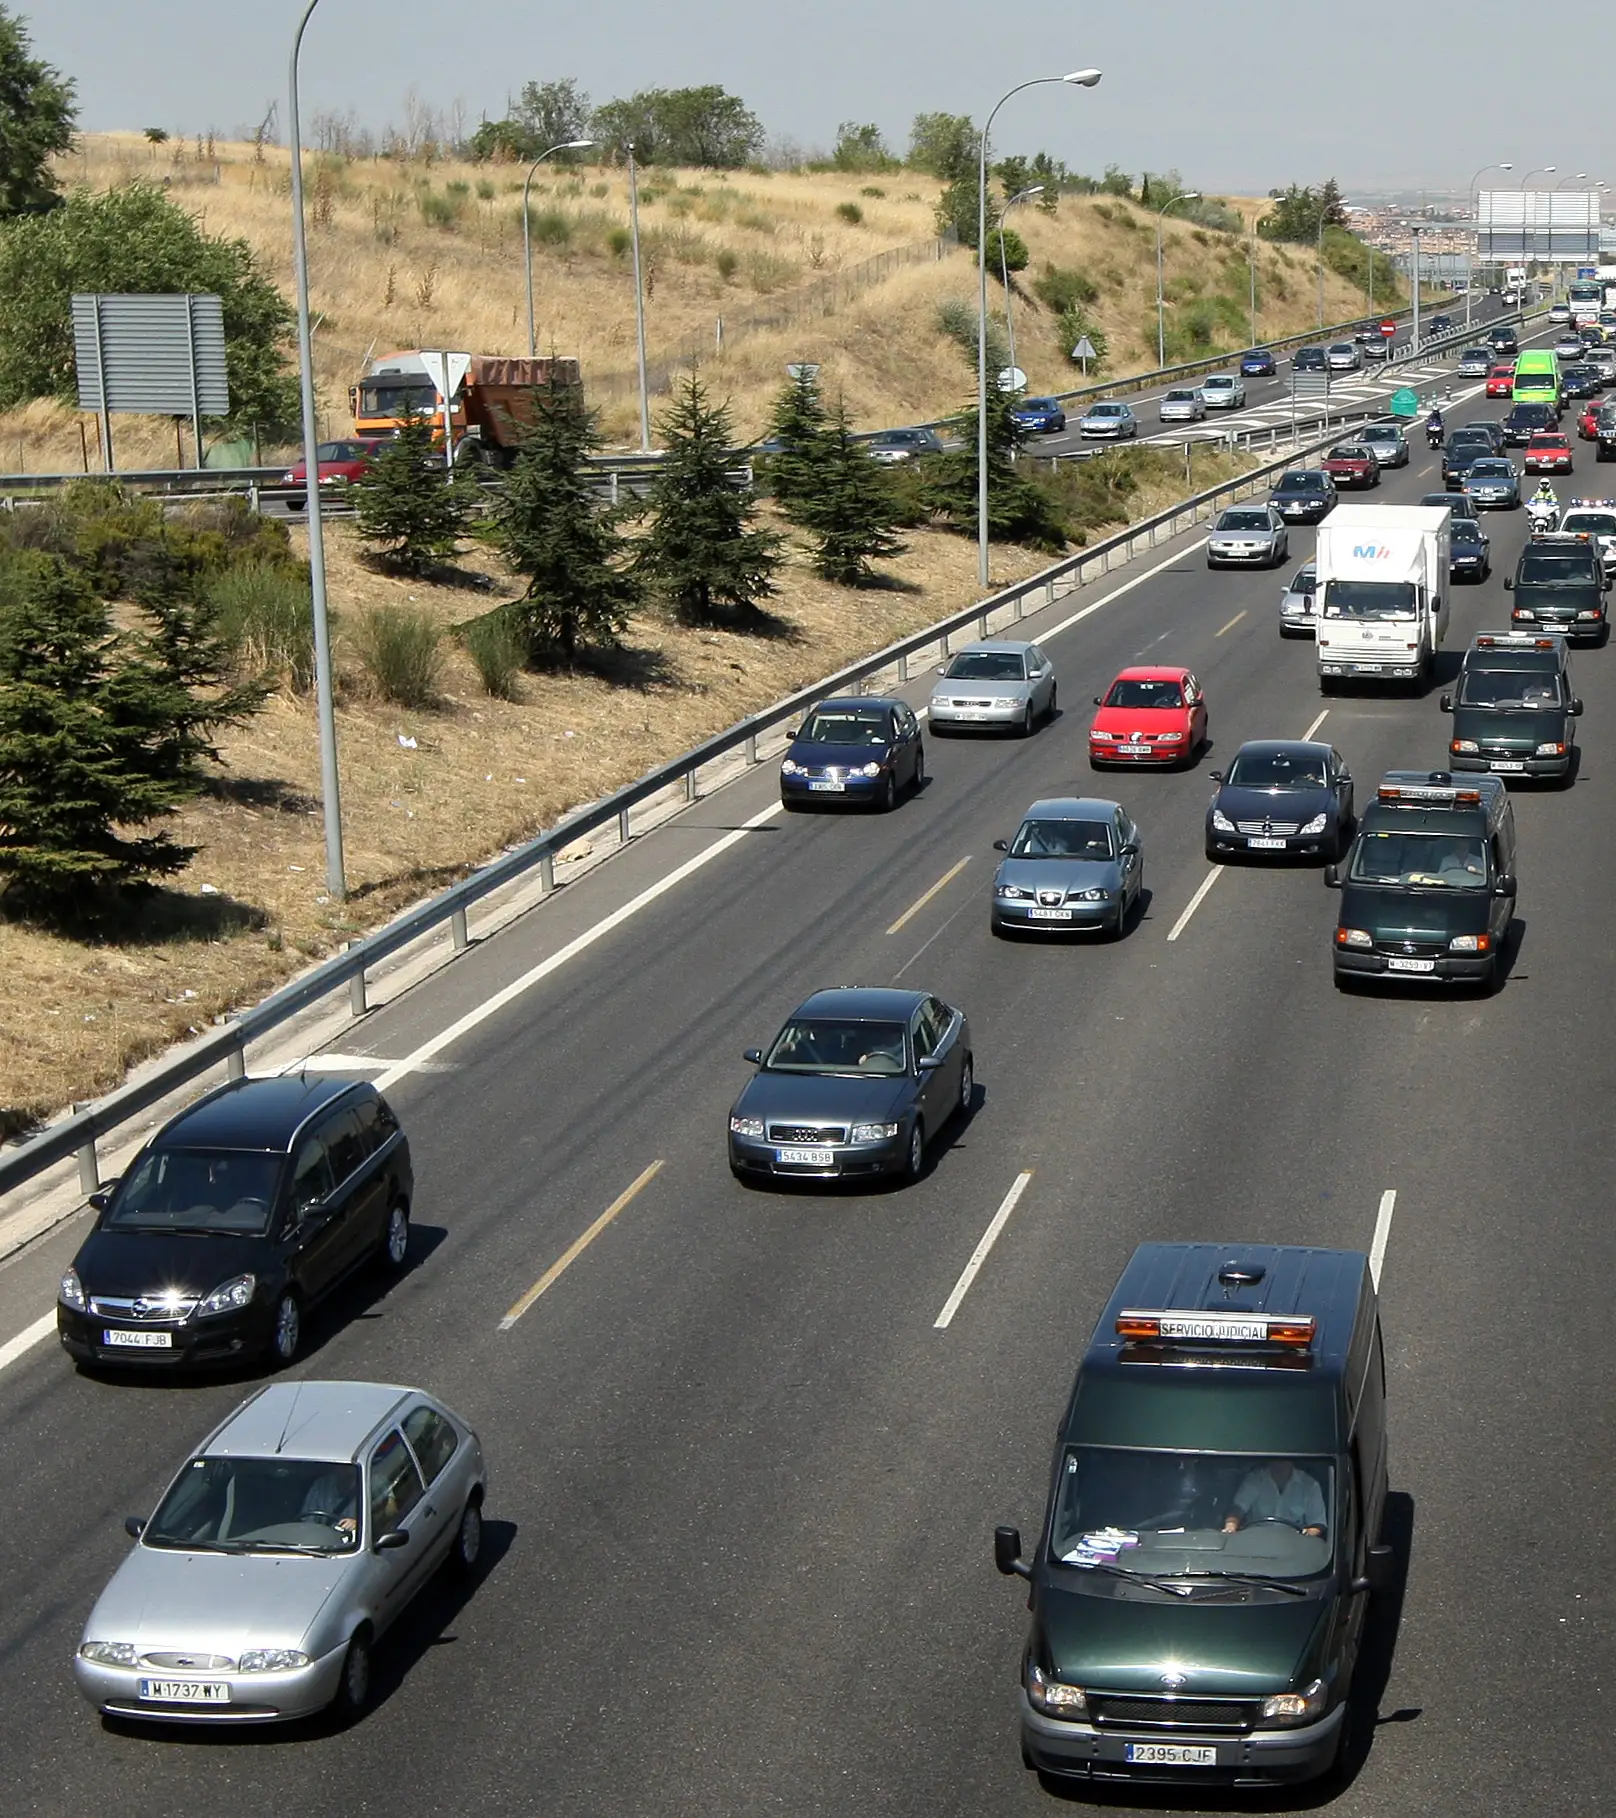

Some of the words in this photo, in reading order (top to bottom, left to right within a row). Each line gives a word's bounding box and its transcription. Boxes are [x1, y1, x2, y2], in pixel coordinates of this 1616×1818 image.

[783, 1151, 808, 1162] 5434
[112, 1331, 140, 1345] 7044
[1161, 1322, 1213, 1338] SERVICIO
[152, 1682, 163, 1696] M
[166, 1683, 200, 1698] 1737
[202, 1684, 222, 1699] WY
[1135, 1745, 1177, 1762] 2395
